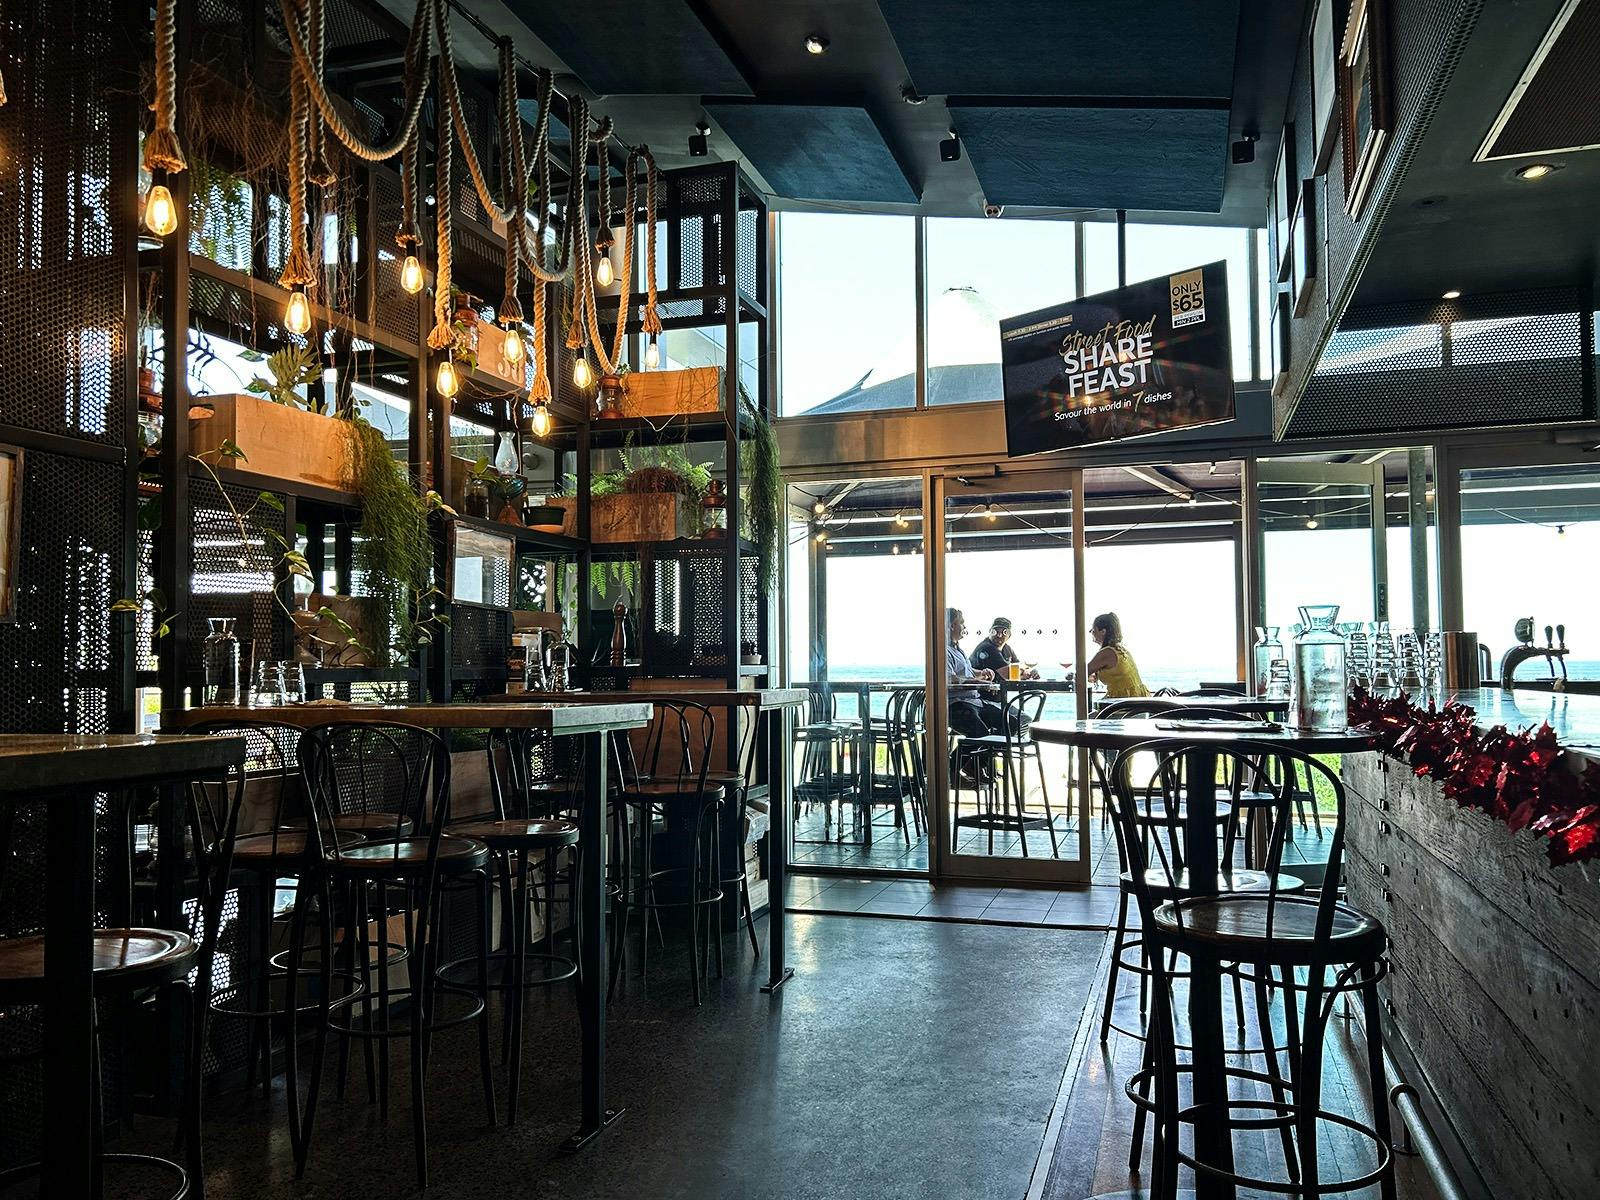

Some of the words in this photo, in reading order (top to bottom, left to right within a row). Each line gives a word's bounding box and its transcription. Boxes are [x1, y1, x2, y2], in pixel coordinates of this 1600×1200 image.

[1172, 280, 1201, 296] ONLY
[1172, 291, 1203, 312] $65
[1059, 322, 1113, 356] Street
[1113, 314, 1157, 345] Food
[1063, 332, 1154, 375] SHARE
[1068, 358, 1151, 398] FEAST
[1054, 409, 1082, 421] Savour
[1083, 404, 1097, 416] the
[1098, 399, 1122, 412] world
[1123, 397, 1132, 407] in
[1132, 391, 1144, 413] 7
[1144, 391, 1172, 404] dishes
